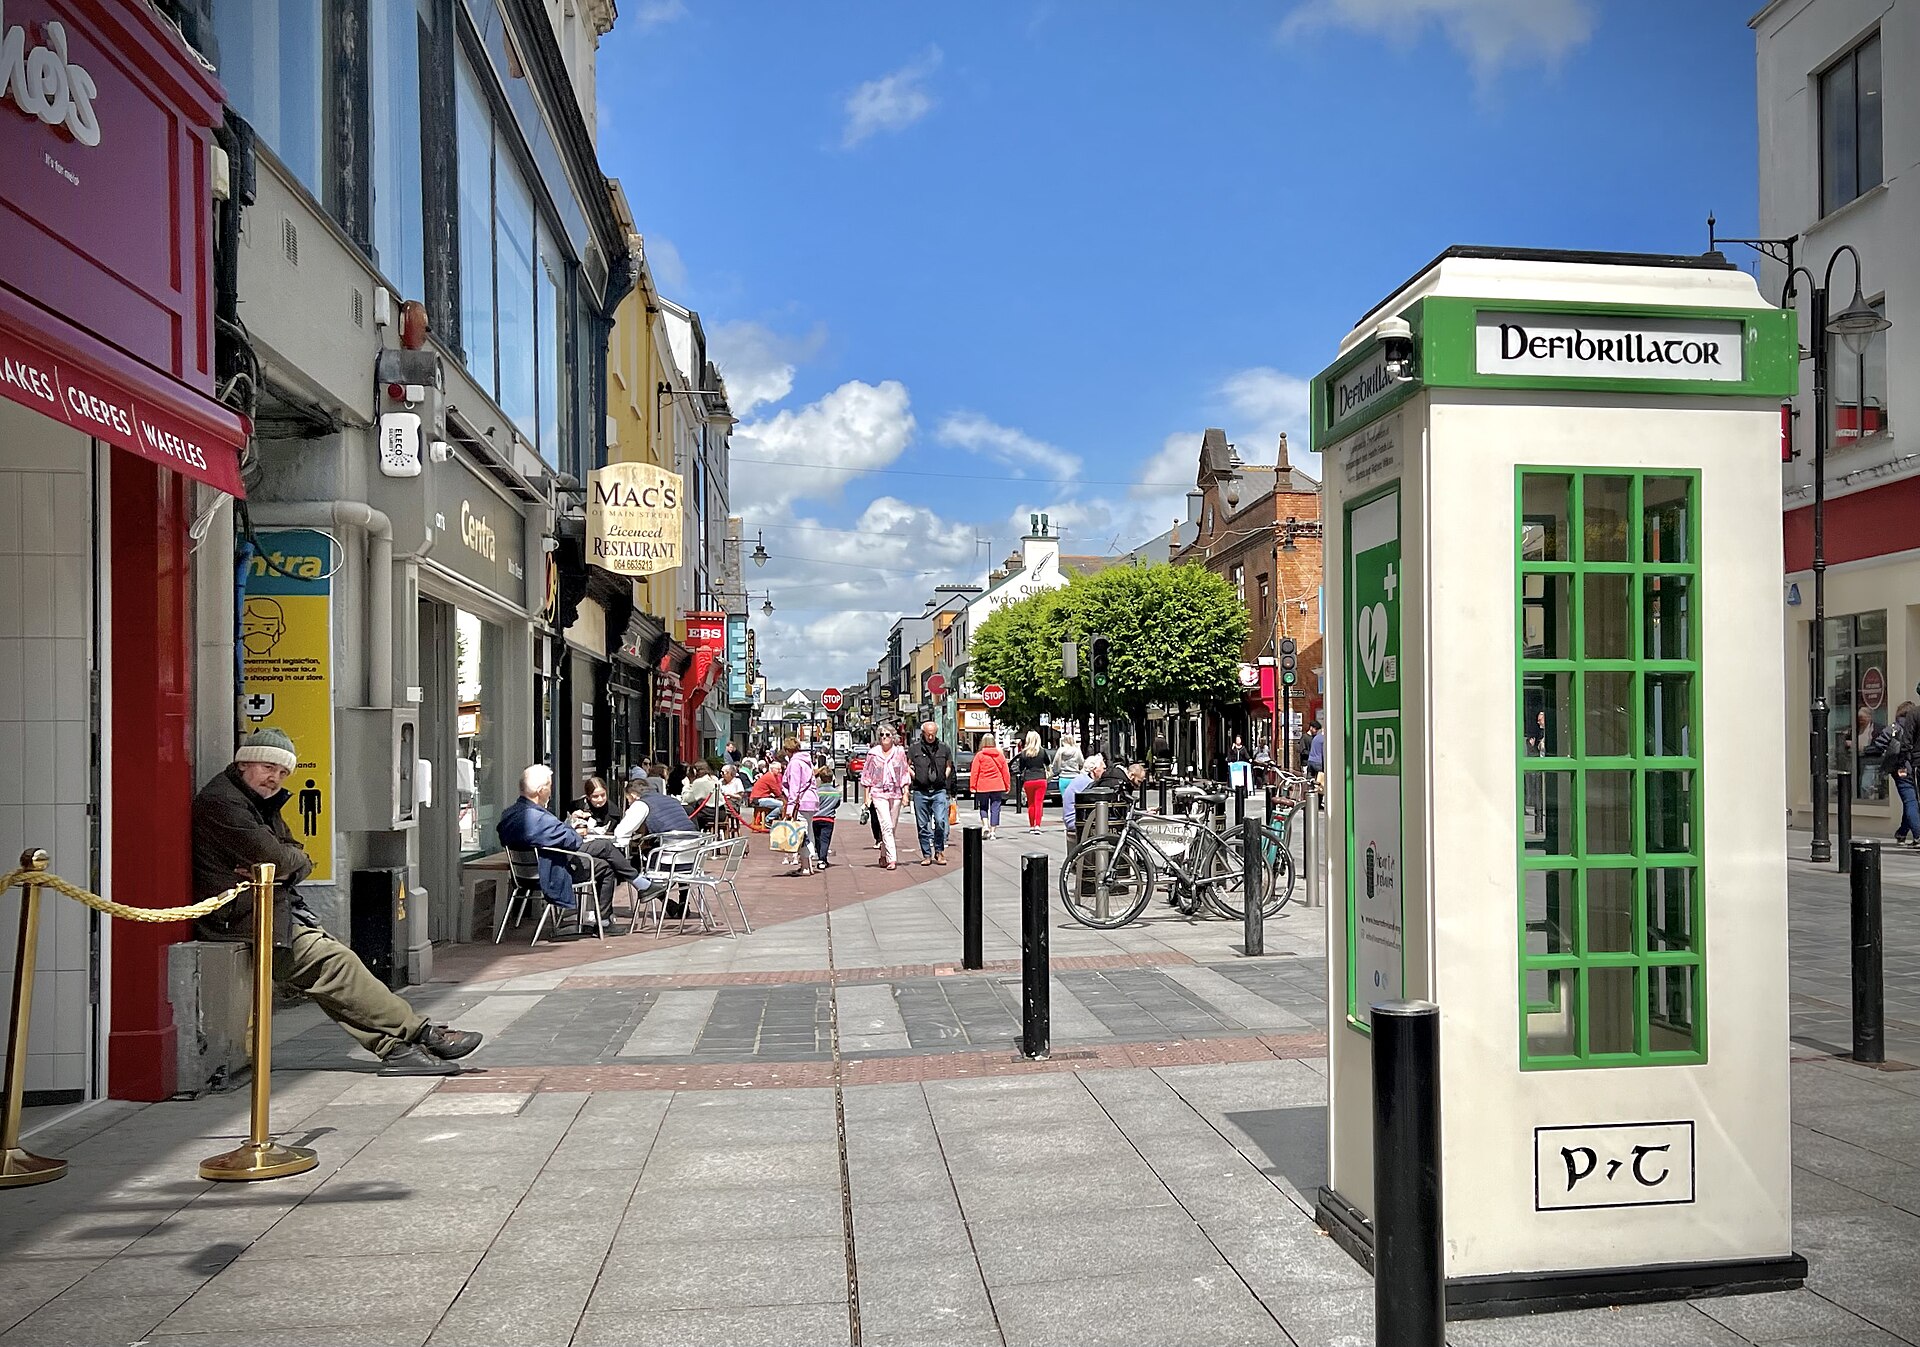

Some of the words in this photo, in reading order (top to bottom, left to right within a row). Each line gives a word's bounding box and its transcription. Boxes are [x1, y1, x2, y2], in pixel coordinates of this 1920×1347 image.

[0, 356, 54, 402] AKES
[67, 386, 132, 436] CREPES
[141, 420, 208, 471] WAFFLES
[395, 428, 403, 456] ELECO
[640, 511, 675, 520] STREET
[461, 499, 496, 563] Centra
[607, 524, 664, 538] Licenced
[593, 537, 676, 559] RESTAURANT
[688, 628, 721, 640] EBS
[250, 674, 283, 683] shopping
[823, 694, 841, 704] STOP
[984, 691, 1004, 700] STOP
[1362, 727, 1396, 765] AED
